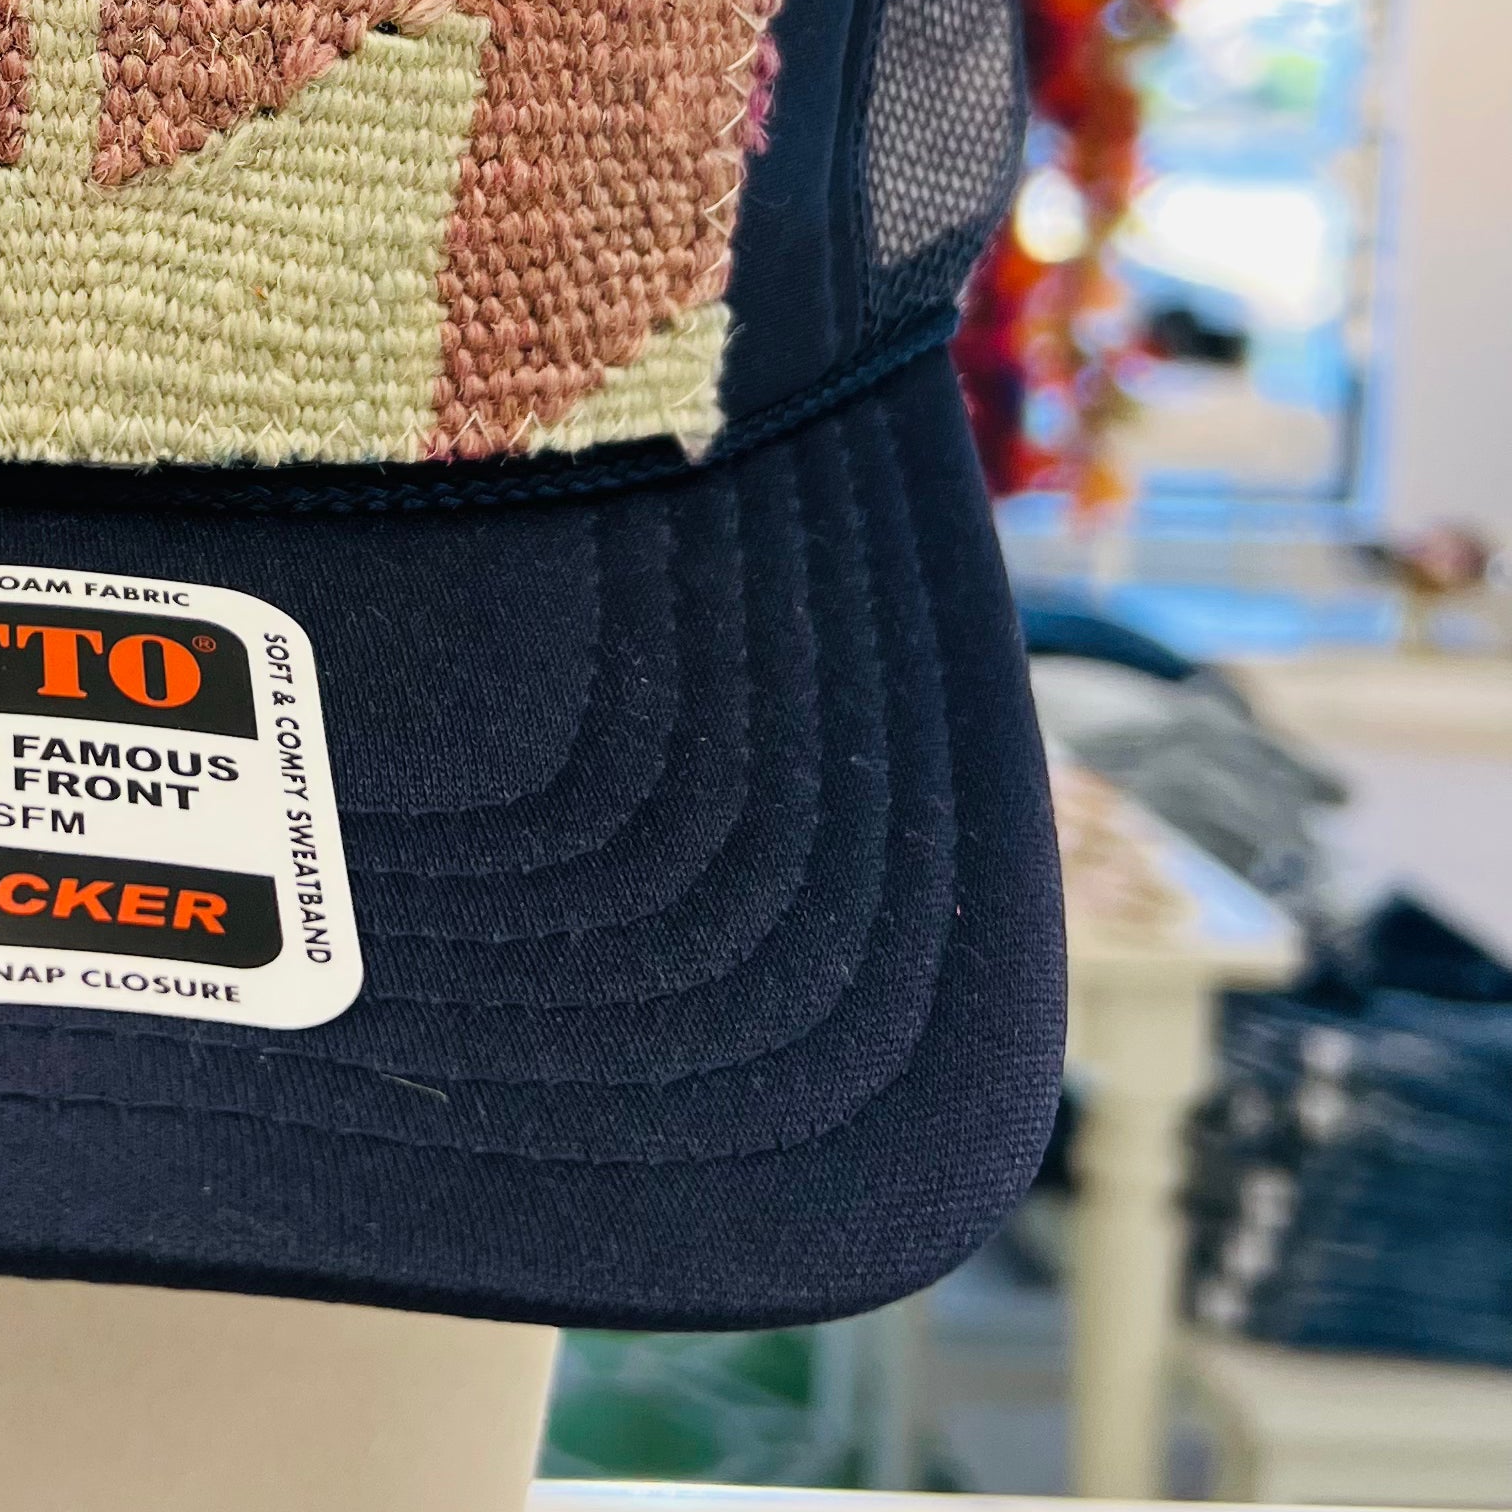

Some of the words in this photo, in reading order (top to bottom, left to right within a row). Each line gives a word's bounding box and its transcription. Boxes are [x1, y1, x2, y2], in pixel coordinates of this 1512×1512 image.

[84, 581, 191, 607] FABRIC
[264, 633, 293, 684] SOFT
[272, 691, 295, 705] &
[12, 734, 240, 782] FAMOUS
[275, 717, 309, 801] COMFY
[13, 767, 199, 810] FRONT
[287, 811, 331, 963] SWEATBAND
[81, 970, 241, 1004] CLOSURE
